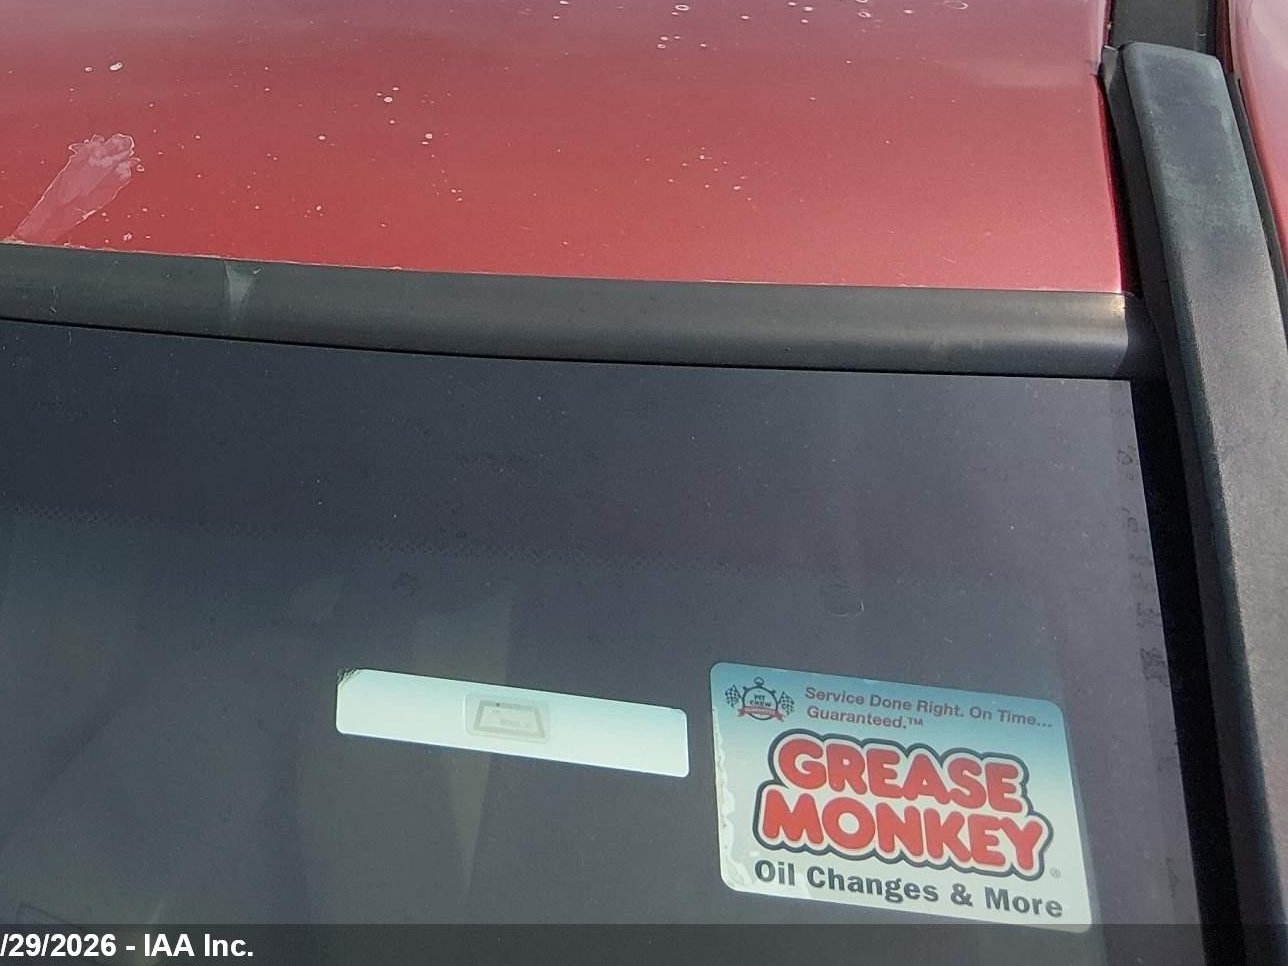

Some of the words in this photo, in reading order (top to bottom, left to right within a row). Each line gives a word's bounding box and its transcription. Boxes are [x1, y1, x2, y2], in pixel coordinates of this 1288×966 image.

[805, 686, 865, 705] Service
[869, 694, 913, 711] Done
[916, 700, 964, 718] Right.
[969, 706, 993, 721] On
[997, 709, 1053, 728] Time...
[776, 737, 1024, 814] GREASE
[762, 789, 1044, 871] MONKEY
[755, 859, 796, 886] Oil
[807, 865, 939, 904] Changes
[950, 883, 974, 907] &
[984, 886, 1063, 918] More
